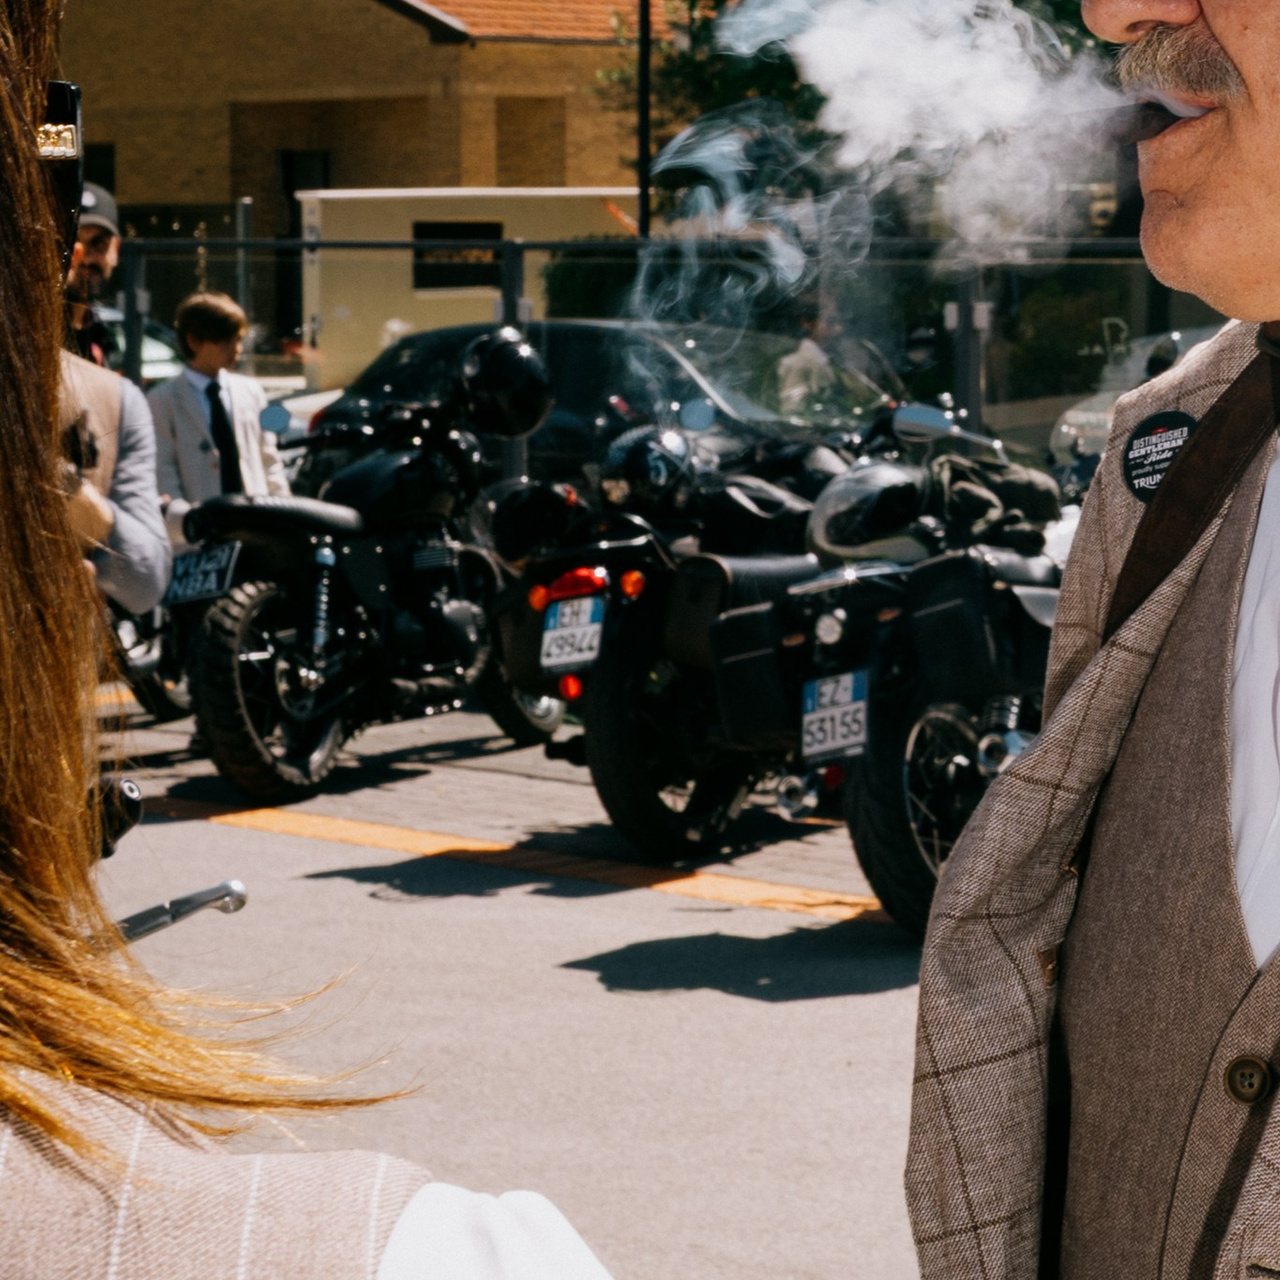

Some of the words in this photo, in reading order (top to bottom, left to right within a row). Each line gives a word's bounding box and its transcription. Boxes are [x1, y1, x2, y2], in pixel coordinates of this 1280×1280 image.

[1132, 427, 1188, 450] DISTINGUISHED
[1143, 450, 1174, 464] Ride
[1133, 472, 1166, 489] TRIUM
[803, 708, 863, 748] 53155
